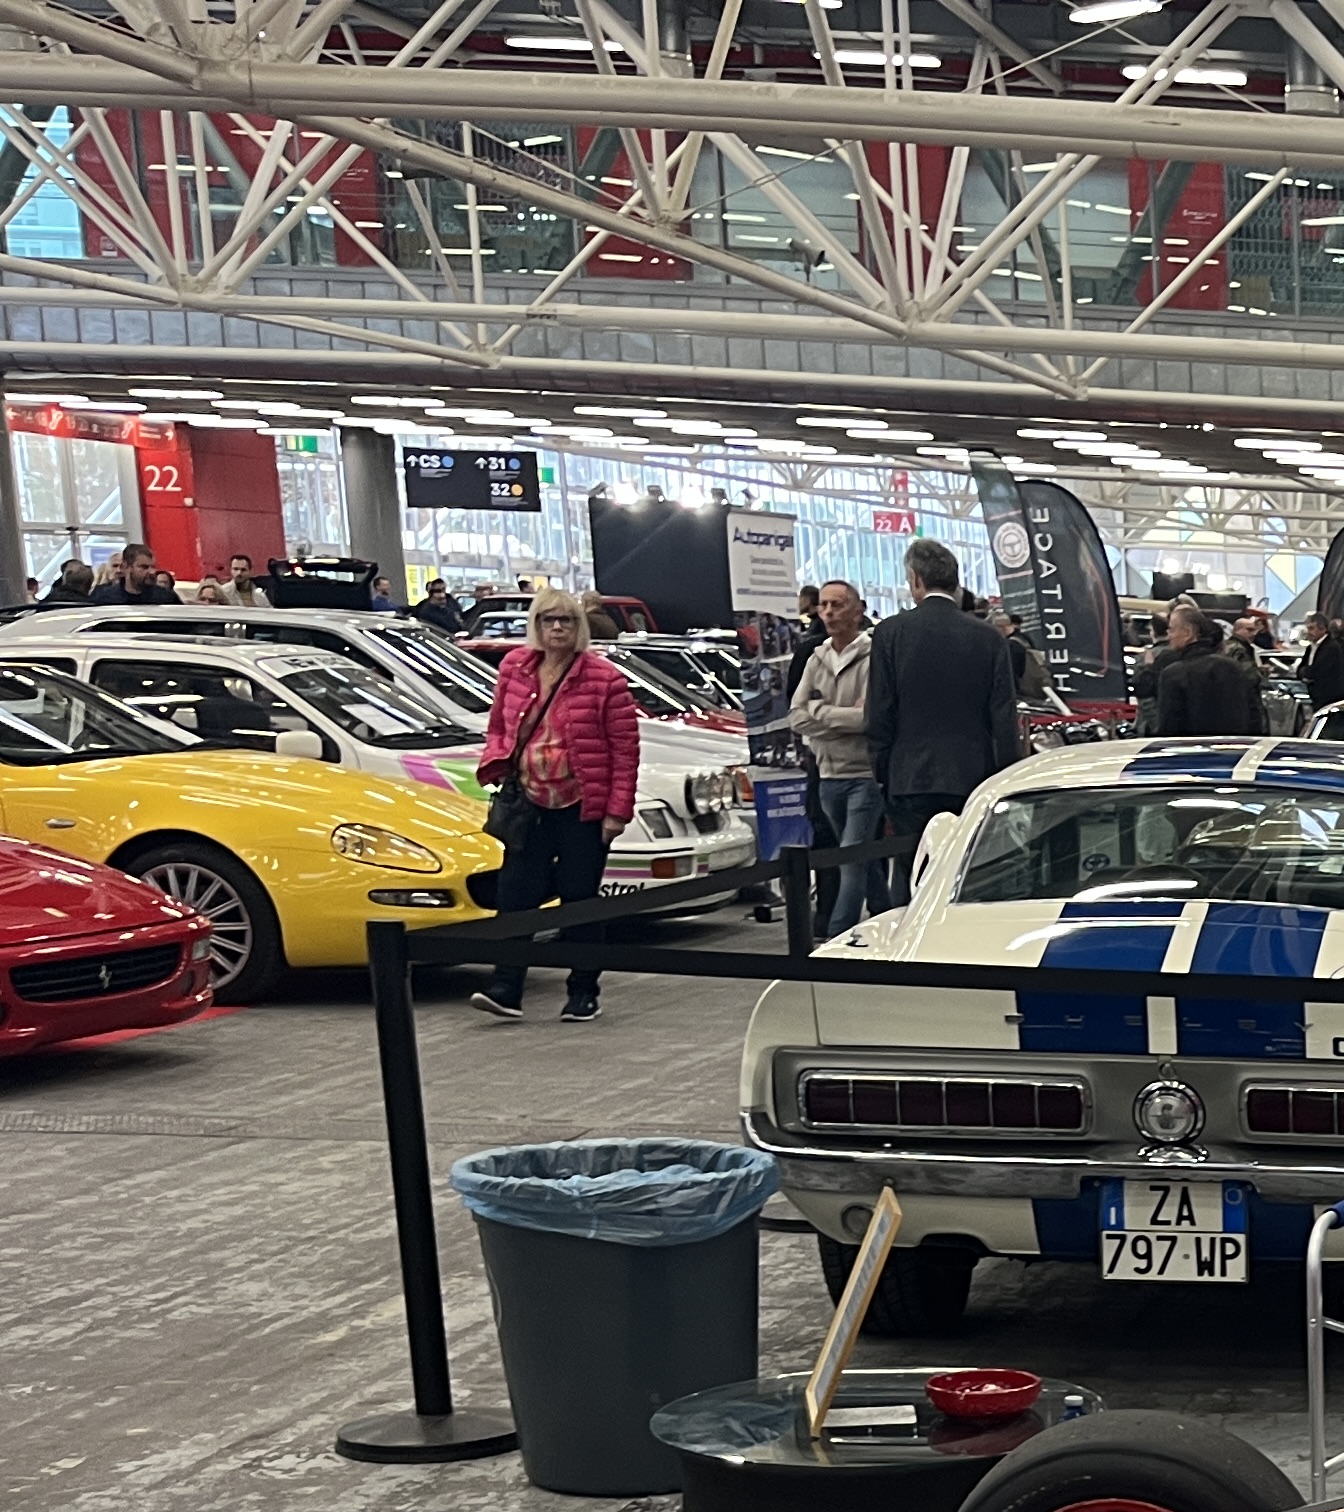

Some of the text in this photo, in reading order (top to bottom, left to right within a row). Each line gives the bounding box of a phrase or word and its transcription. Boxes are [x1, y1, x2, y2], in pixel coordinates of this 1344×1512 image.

[419, 454, 441, 469] CS
[488, 456, 506, 470] 31
[144, 465, 182, 491] 22
[490, 482, 511, 496] 32
[875, 519, 893, 532] 22
[899, 516, 913, 533] A
[1149, 1185, 1197, 1227] ZA
[1109, 1206, 1117, 1226] I
[1105, 1233, 1242, 1278] 797 WP
